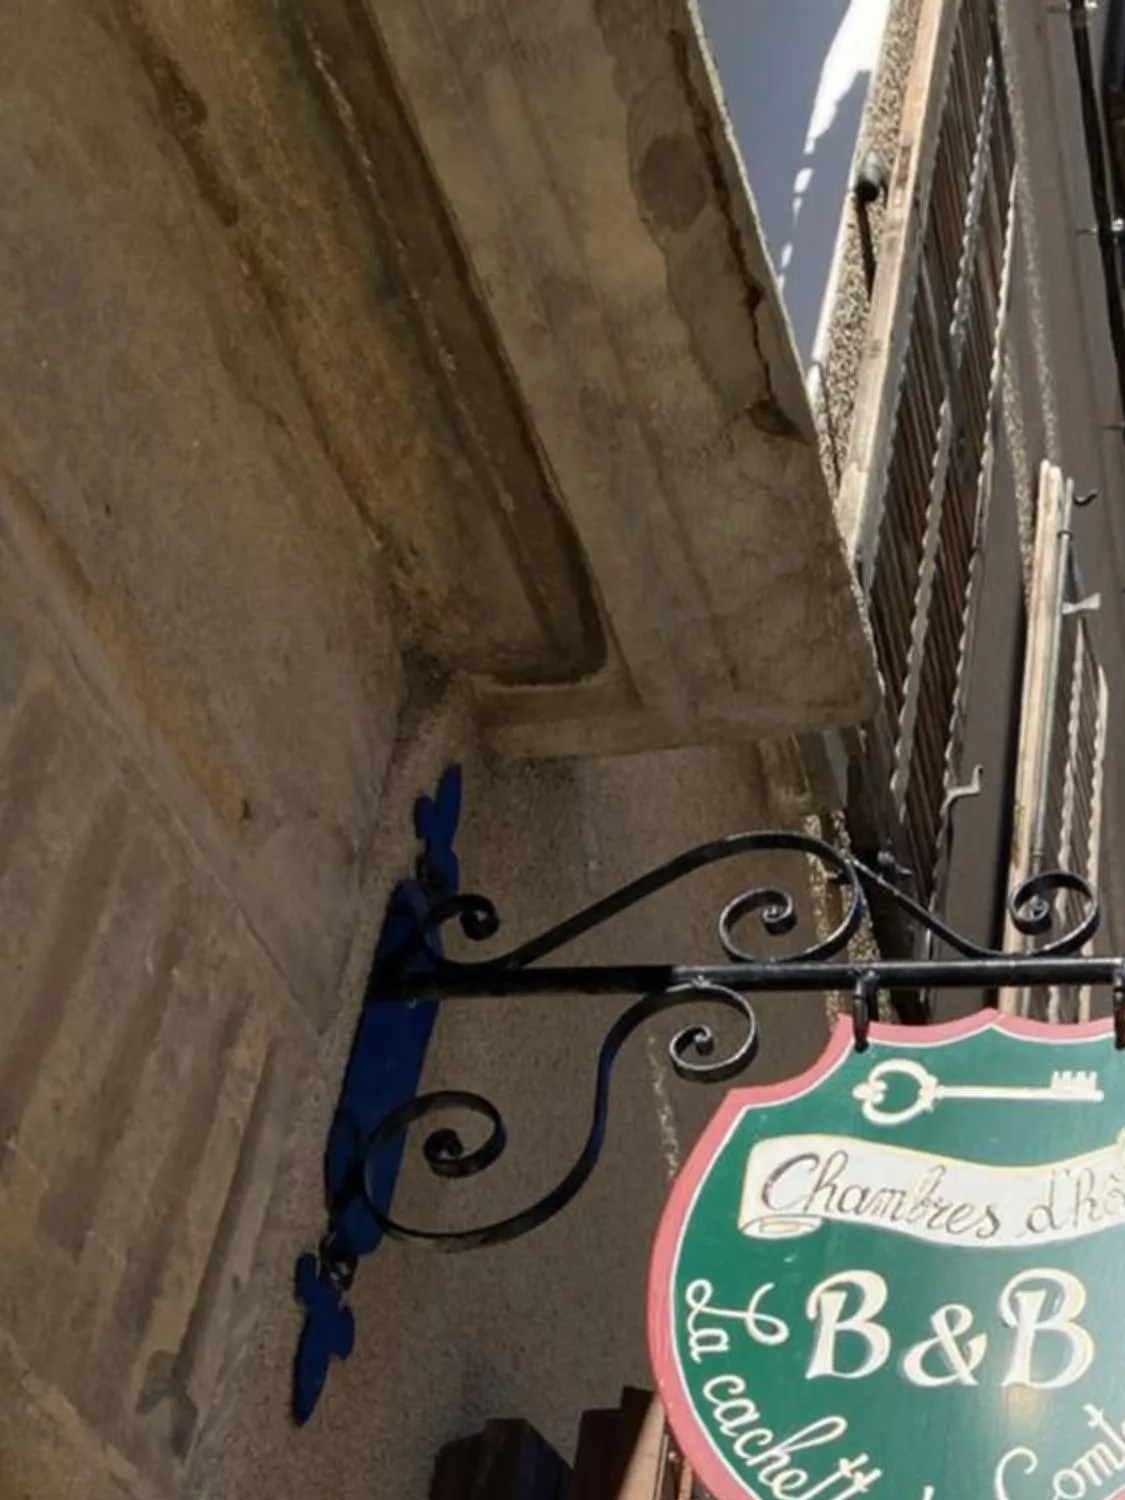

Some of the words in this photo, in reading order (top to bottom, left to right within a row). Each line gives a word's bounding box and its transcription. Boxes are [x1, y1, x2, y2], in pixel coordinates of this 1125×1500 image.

[762, 1150, 1001, 1240] Chambres
[685, 1279, 790, 1364] La
[805, 1270, 1096, 1390] B&B
